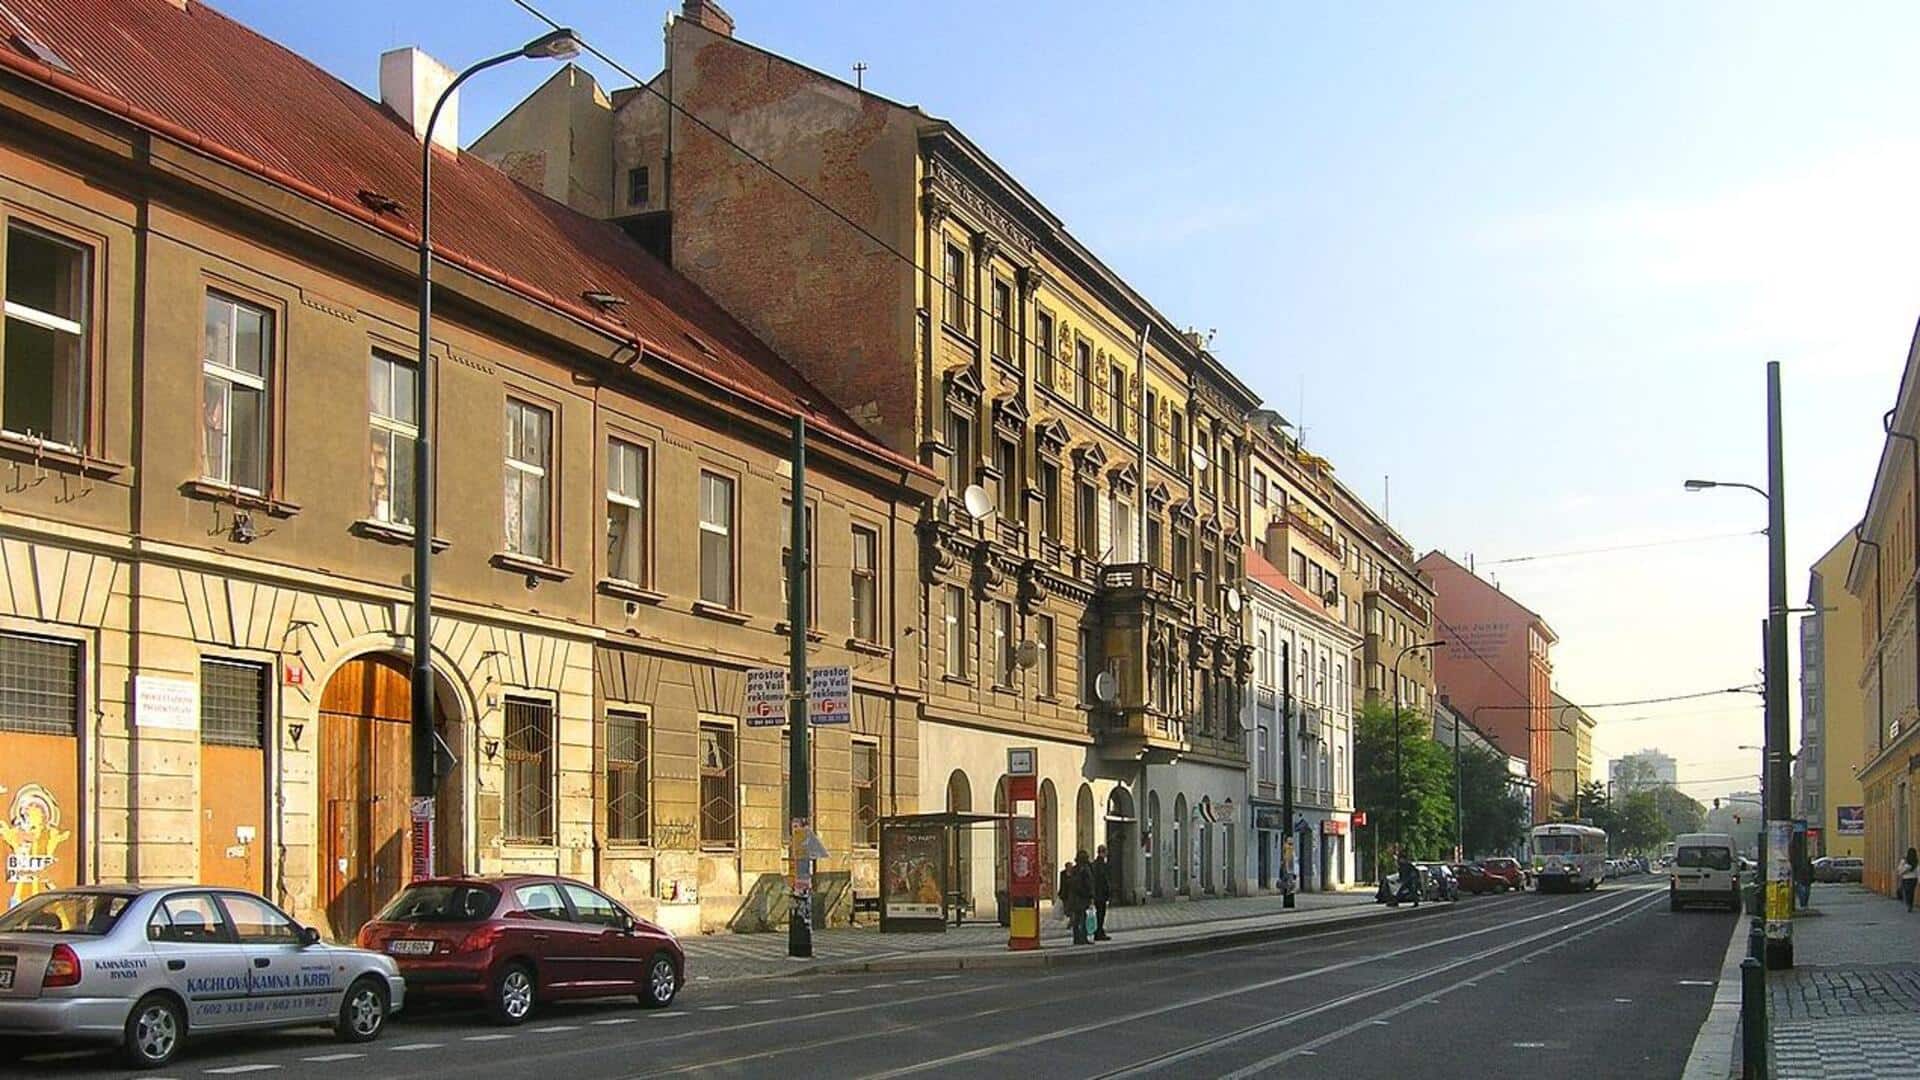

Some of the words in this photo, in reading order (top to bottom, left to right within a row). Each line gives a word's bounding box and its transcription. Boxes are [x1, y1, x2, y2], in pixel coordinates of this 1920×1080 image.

[747, 670, 784, 683] prostor
[812, 668, 848, 679] prostor
[747, 683, 763, 693] pro
[812, 680, 828, 690] pro
[747, 691, 784, 702] reklamu
[812, 688, 848, 698] reklamu
[252, 974, 290, 988] KAMNA
[294, 974, 301, 987] A
[303, 972, 331, 986] KRBY
